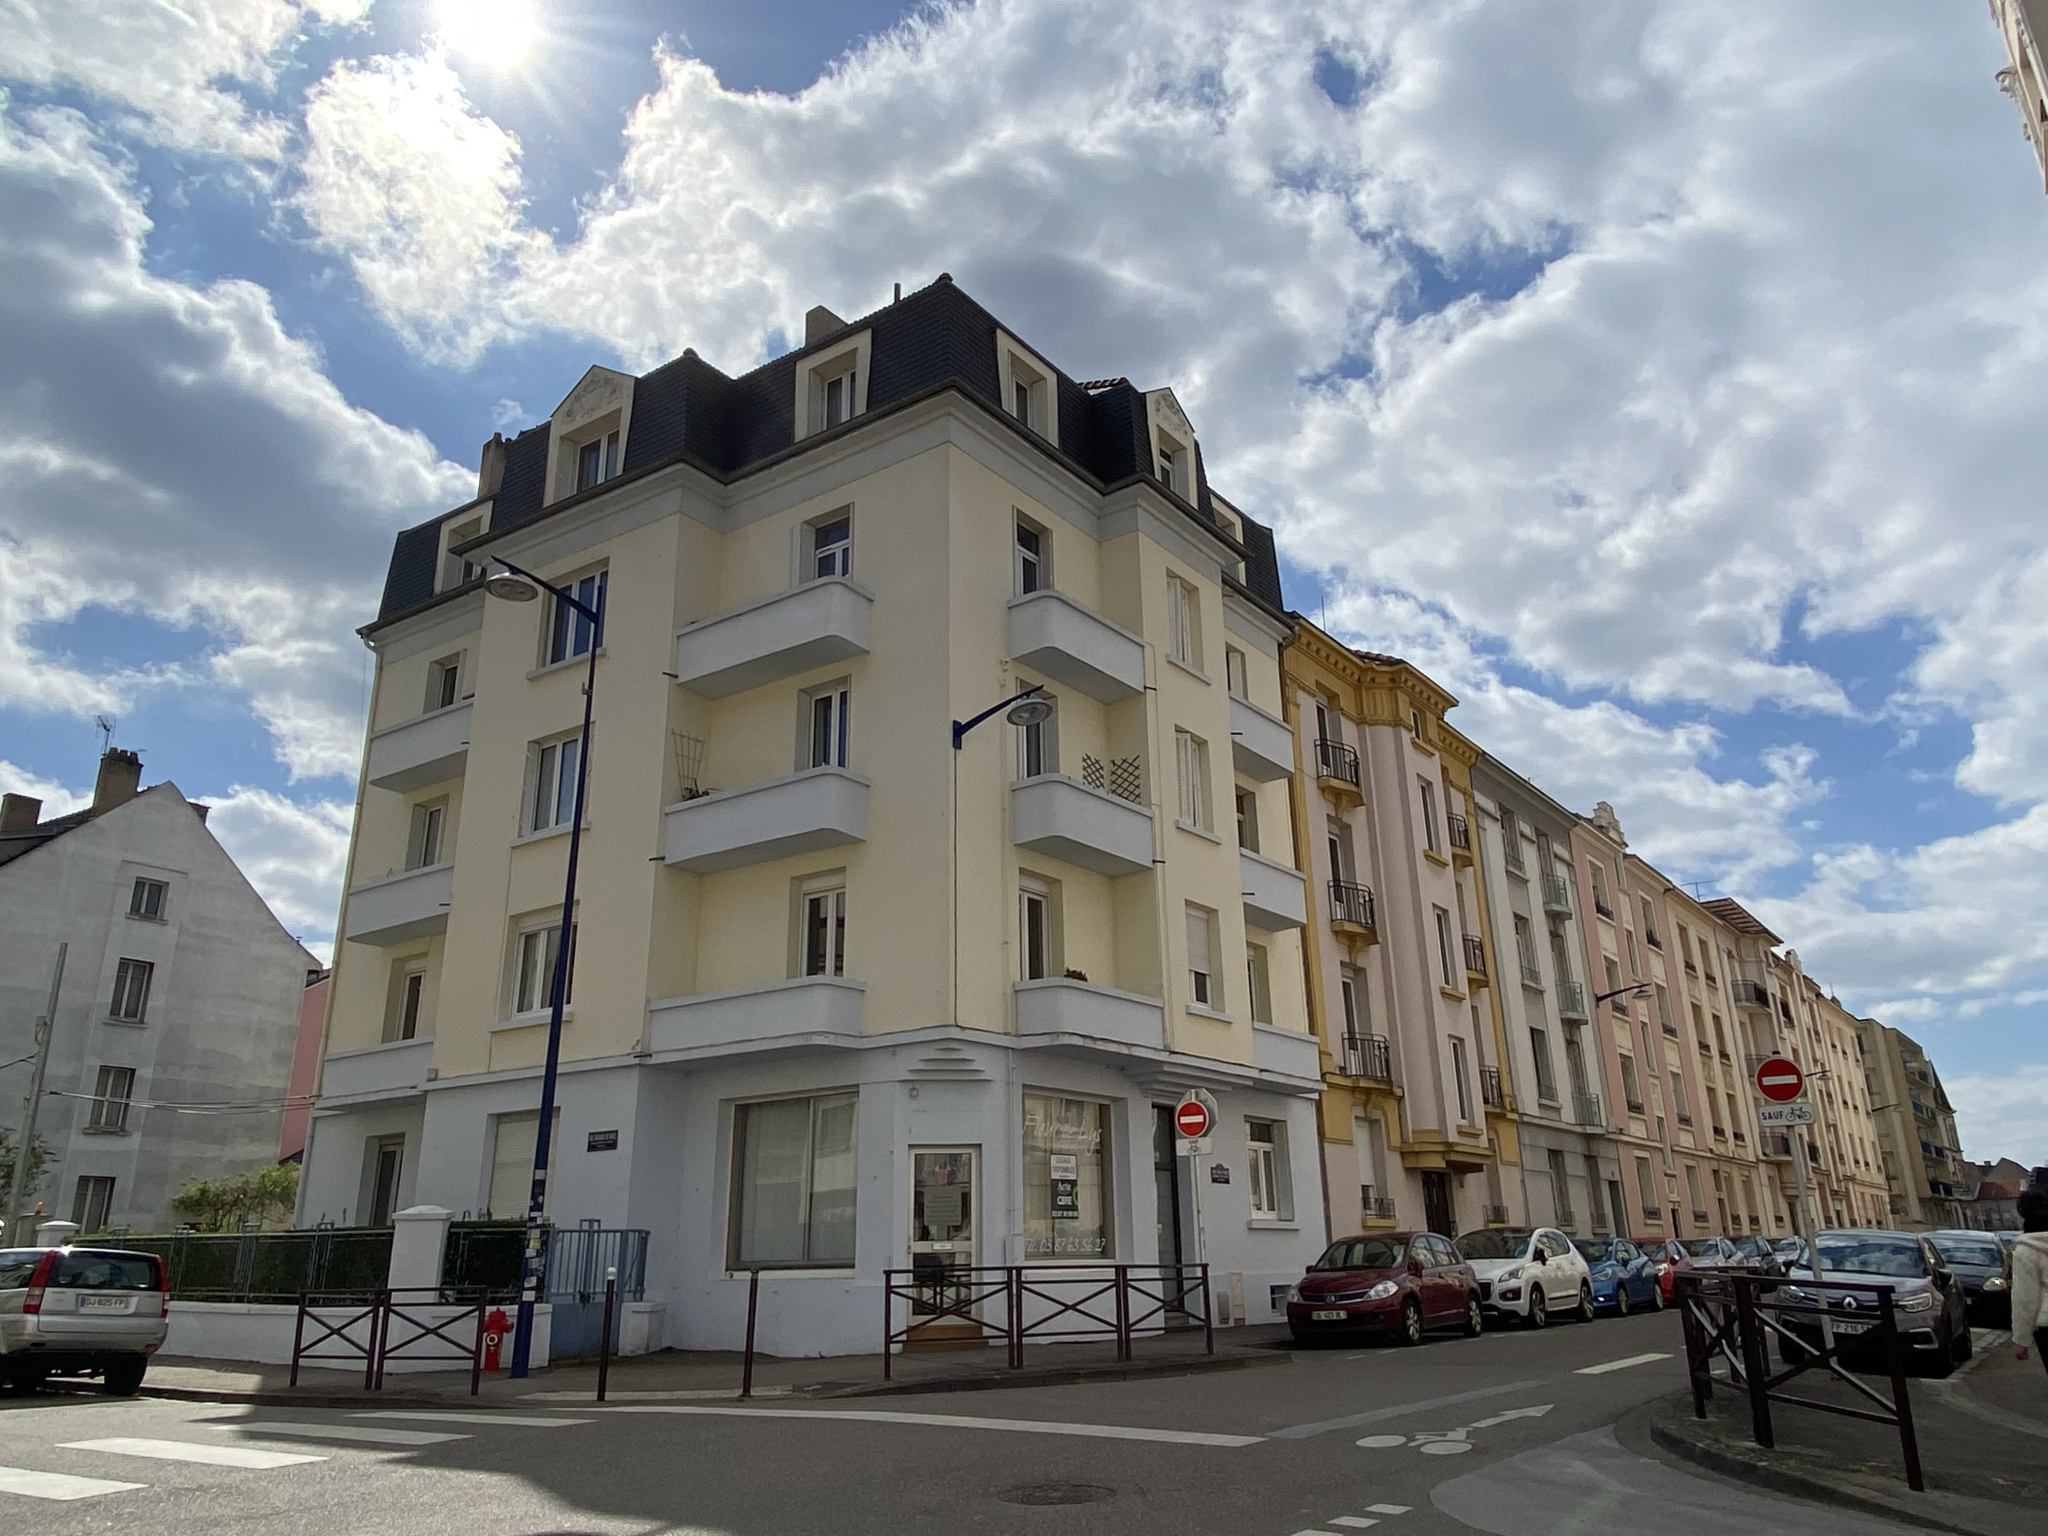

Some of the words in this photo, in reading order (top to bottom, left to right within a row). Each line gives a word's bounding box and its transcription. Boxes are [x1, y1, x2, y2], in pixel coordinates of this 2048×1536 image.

[1761, 1111, 1784, 1120] SAUF
[1079, 1118, 1102, 1156] Lys
[1054, 1237, 1066, 1252] 87
[1067, 1236, 1079, 1252] 63
[1081, 1236, 1093, 1252] 56
